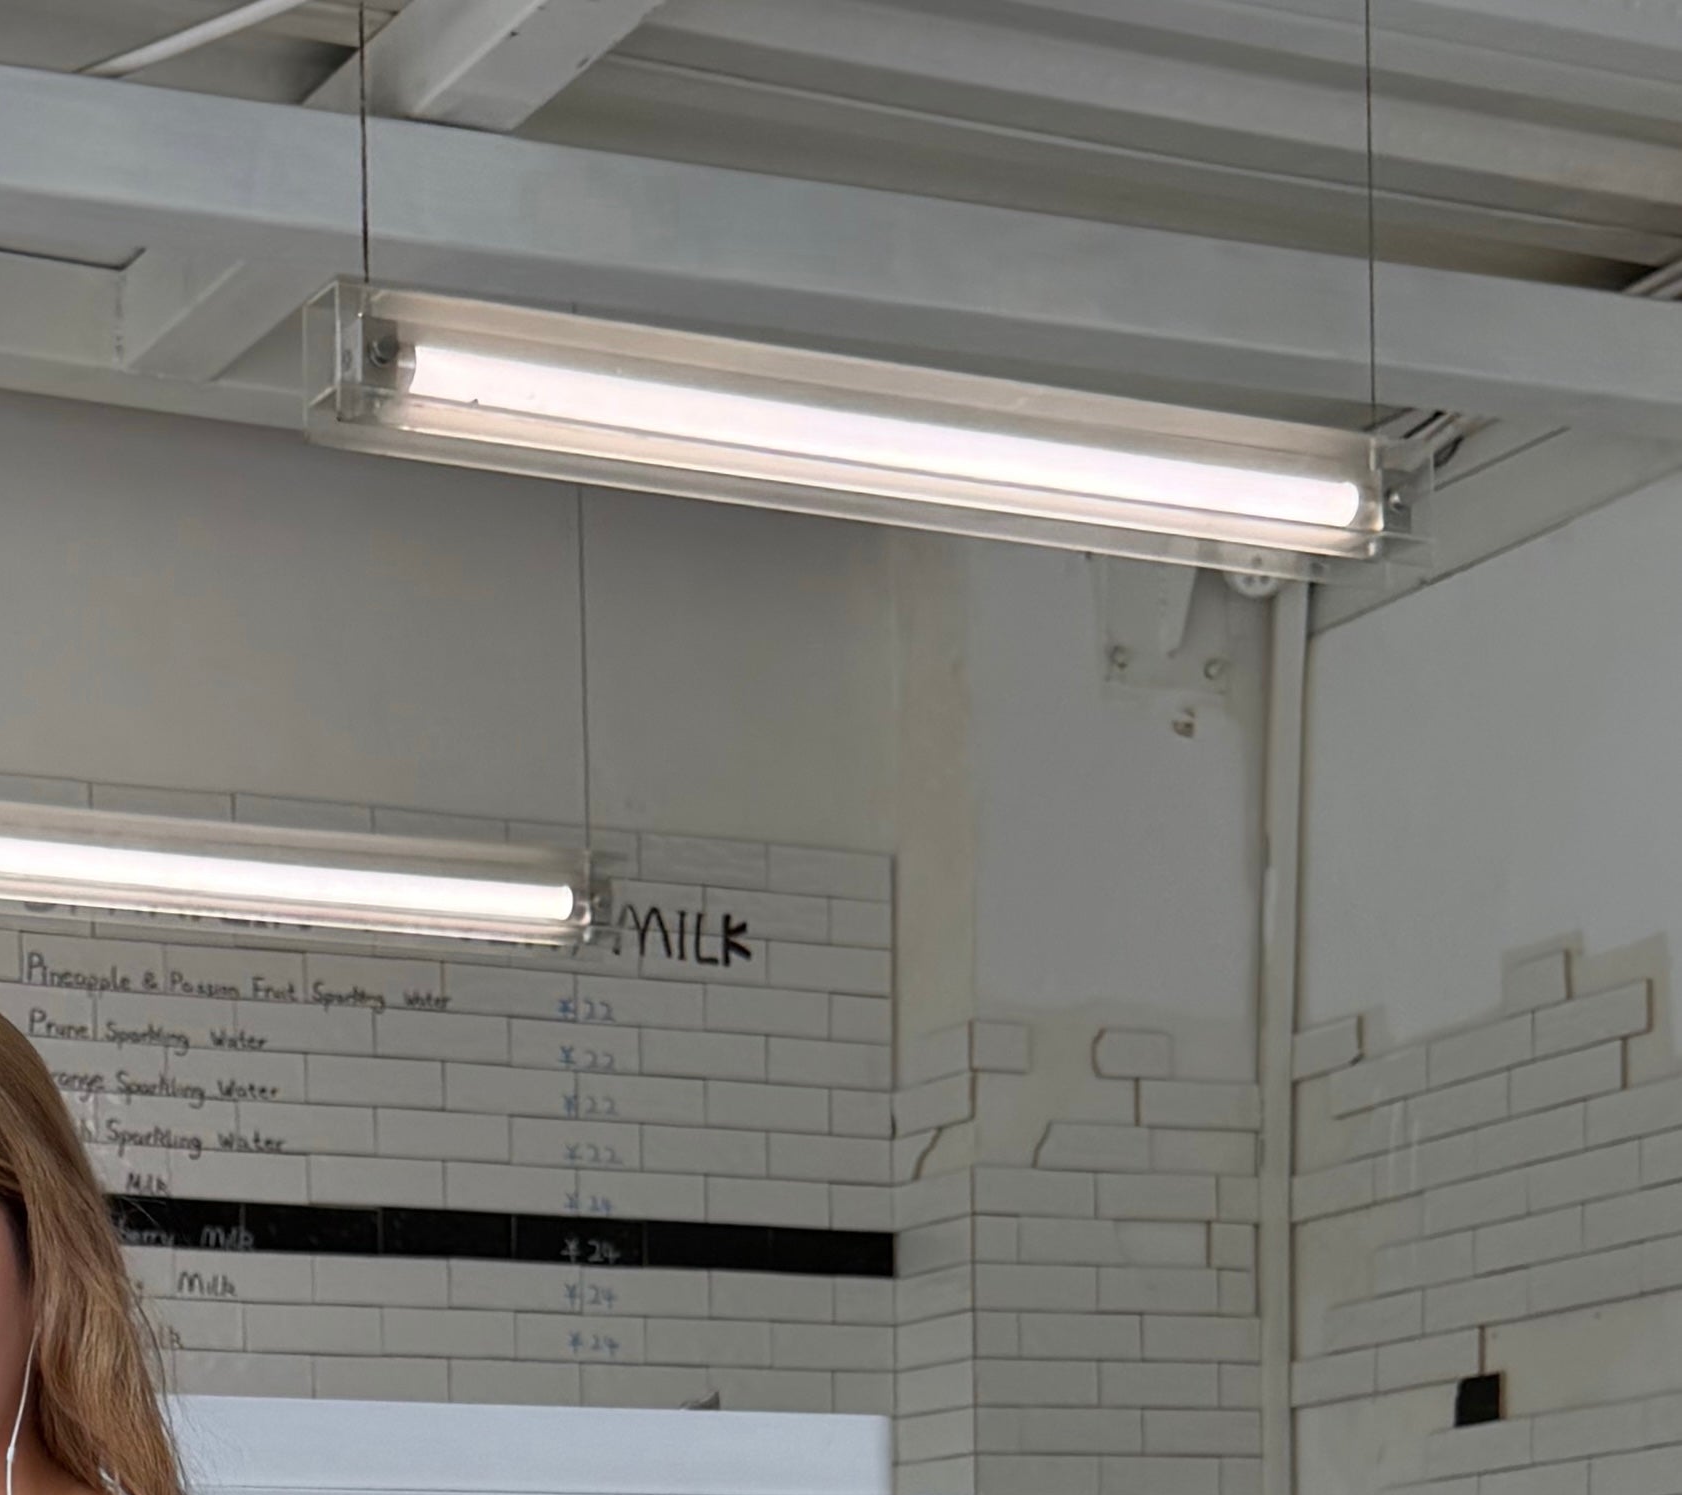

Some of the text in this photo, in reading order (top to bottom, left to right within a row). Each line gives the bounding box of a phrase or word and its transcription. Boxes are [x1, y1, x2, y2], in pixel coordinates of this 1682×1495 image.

[613, 904, 752, 967] MILK
[29, 1008, 90, 1042] Prune
[52, 1072, 105, 1101] range
[218, 1079, 280, 1101] Water
[177, 1271, 237, 1296] Milk
